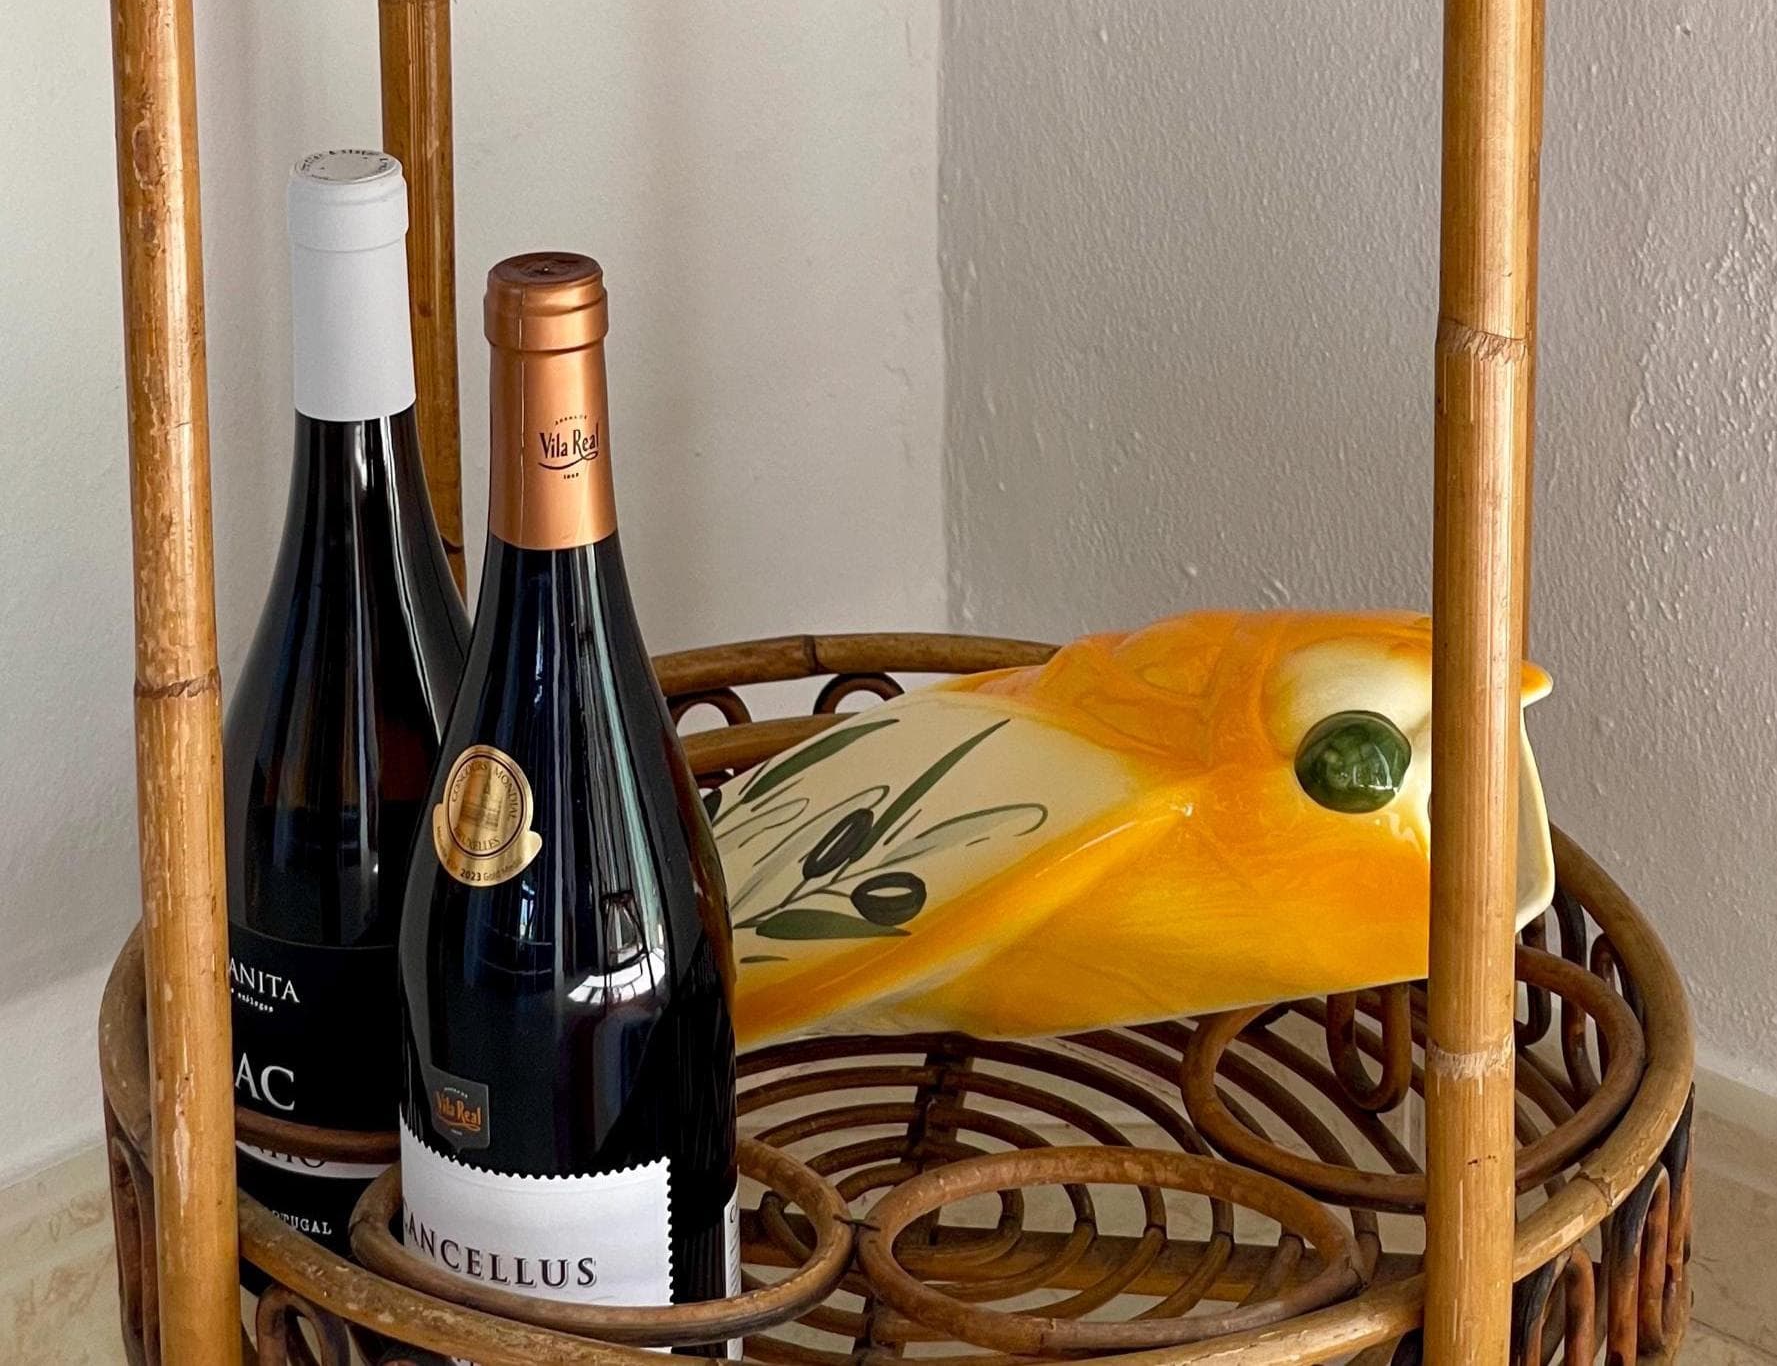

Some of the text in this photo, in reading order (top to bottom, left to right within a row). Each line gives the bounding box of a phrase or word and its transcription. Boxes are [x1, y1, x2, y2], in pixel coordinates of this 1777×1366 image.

[538, 422, 600, 460] Vila Real
[494, 767, 520, 819] MONDIAL
[459, 868, 482, 882] 2023
[456, 1099, 481, 1125] Real
